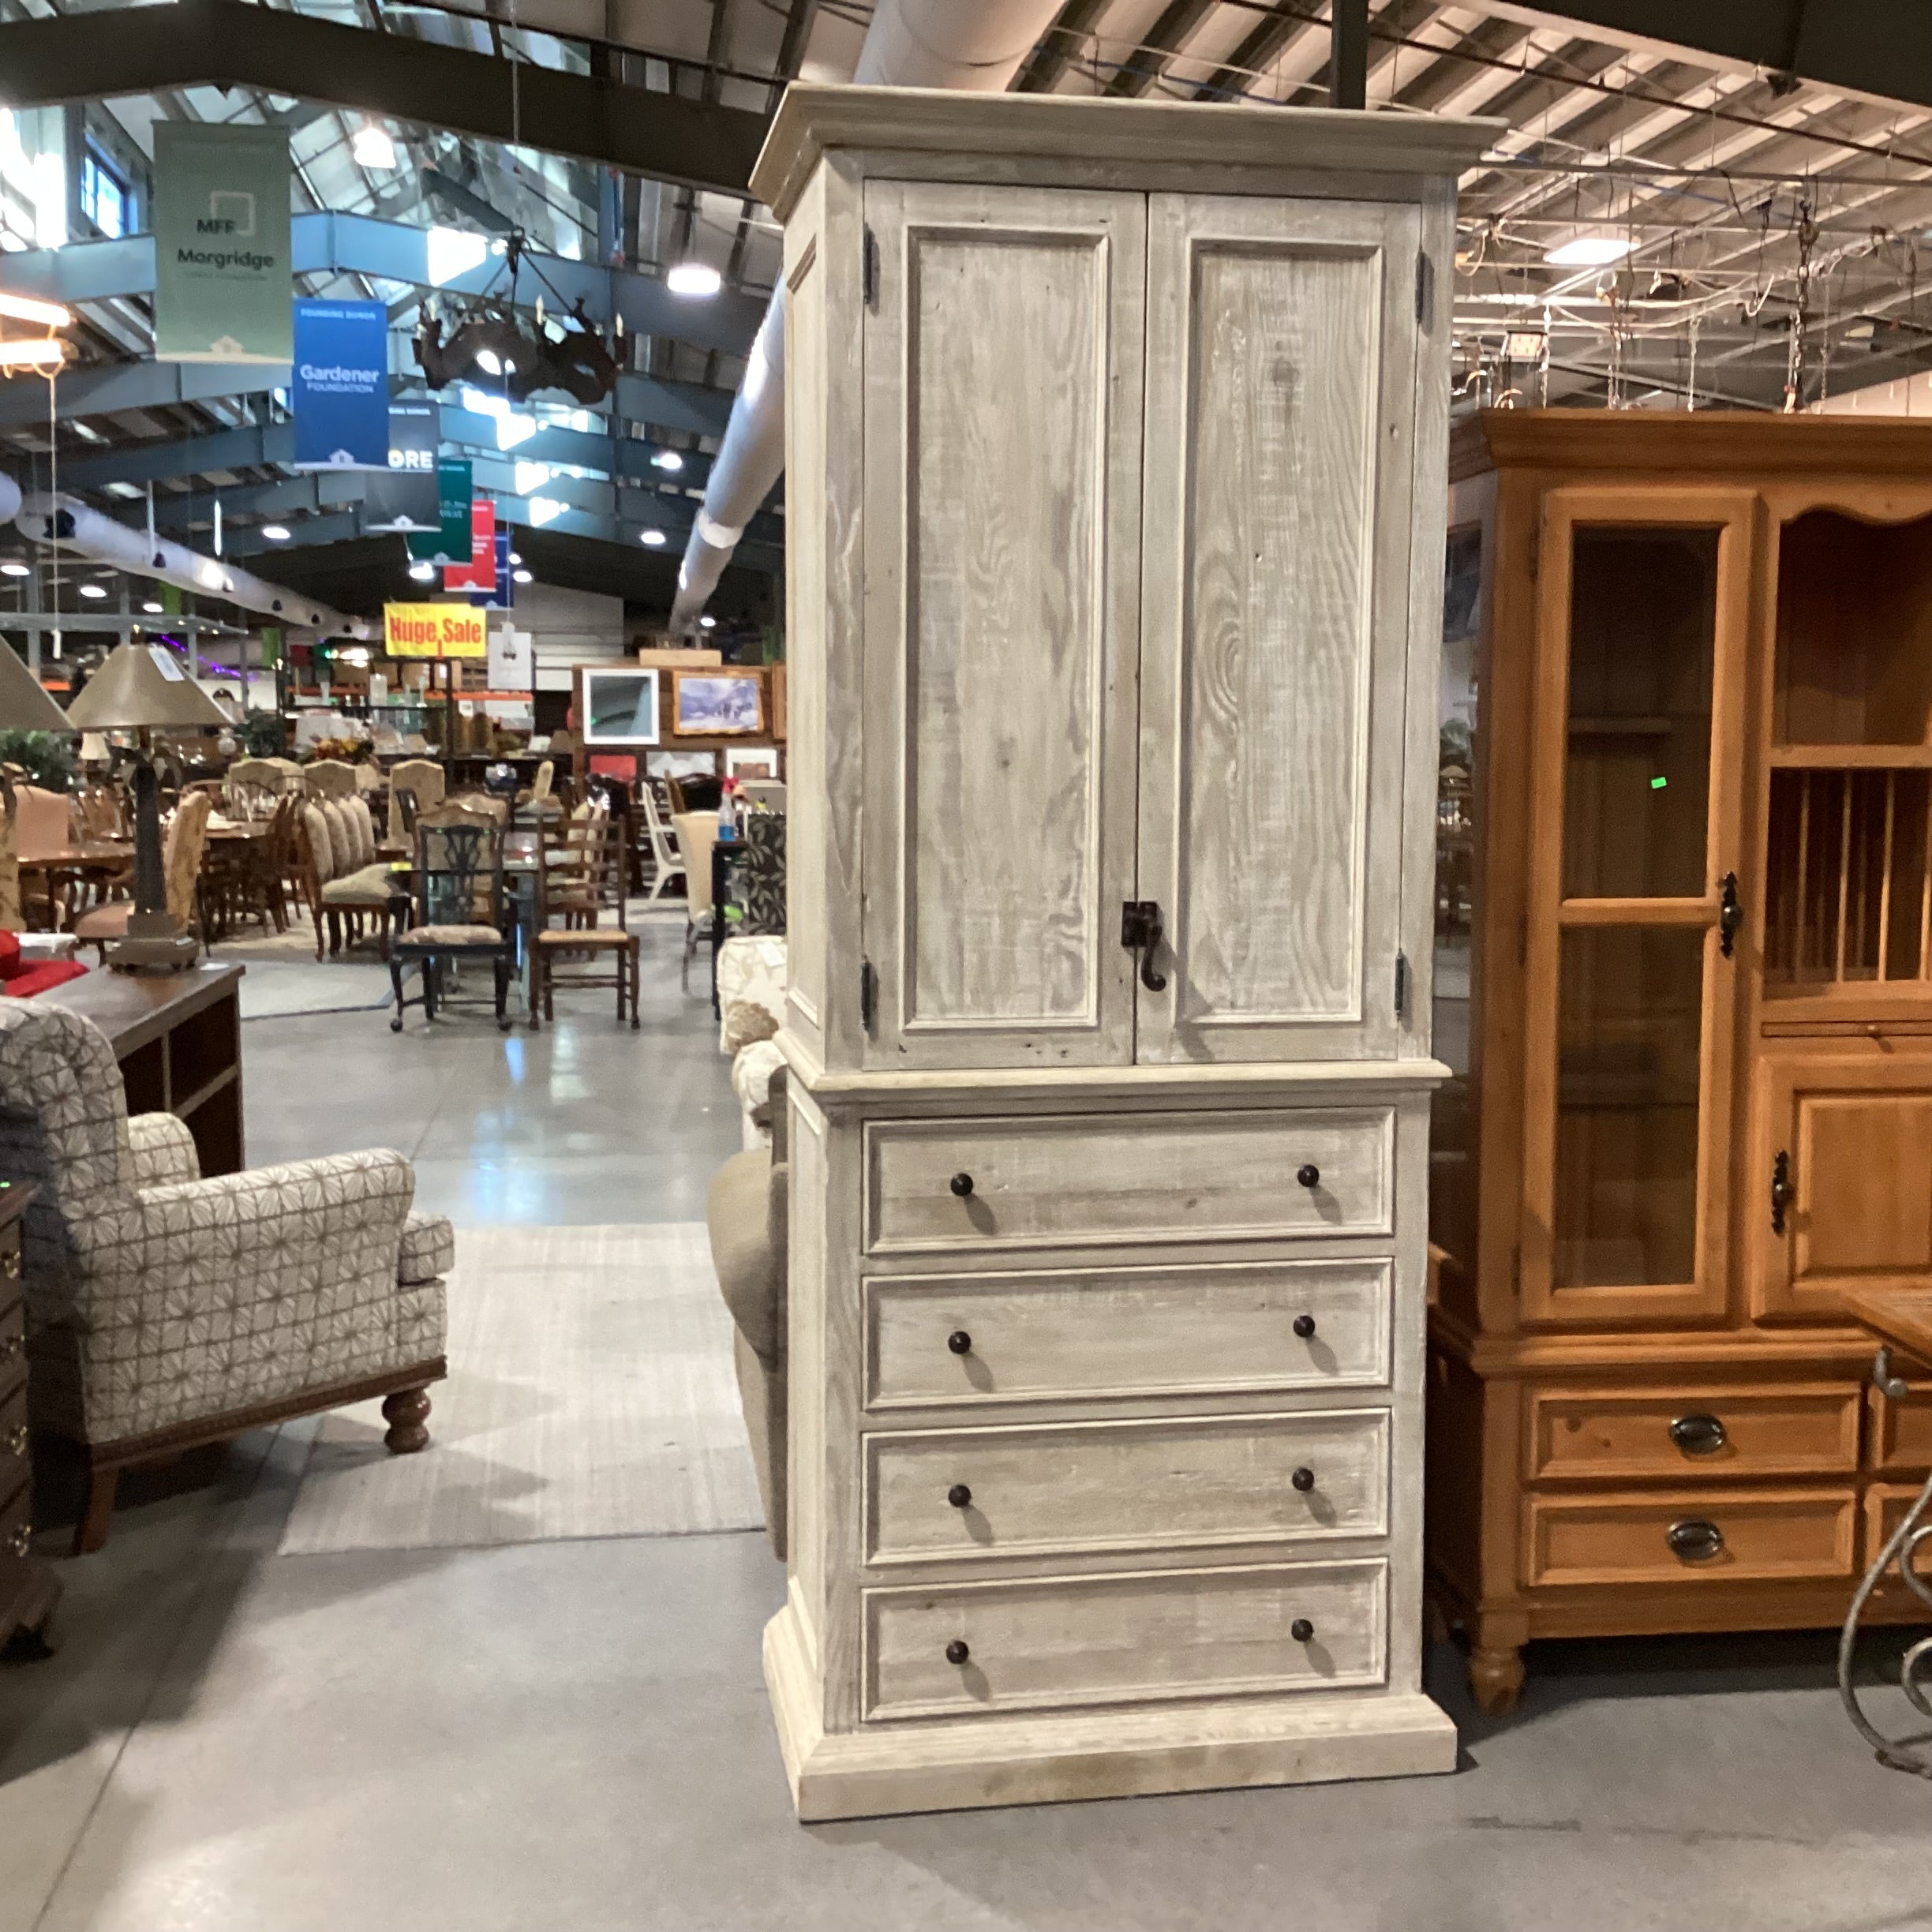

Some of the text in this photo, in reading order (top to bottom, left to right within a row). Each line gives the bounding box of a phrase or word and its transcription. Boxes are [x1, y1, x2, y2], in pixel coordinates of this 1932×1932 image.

[197, 219, 235, 234] MFF
[177, 246, 274, 271] Morgridge
[299, 364, 380, 383] Gardener
[389, 617, 482, 644] Huge Sale
